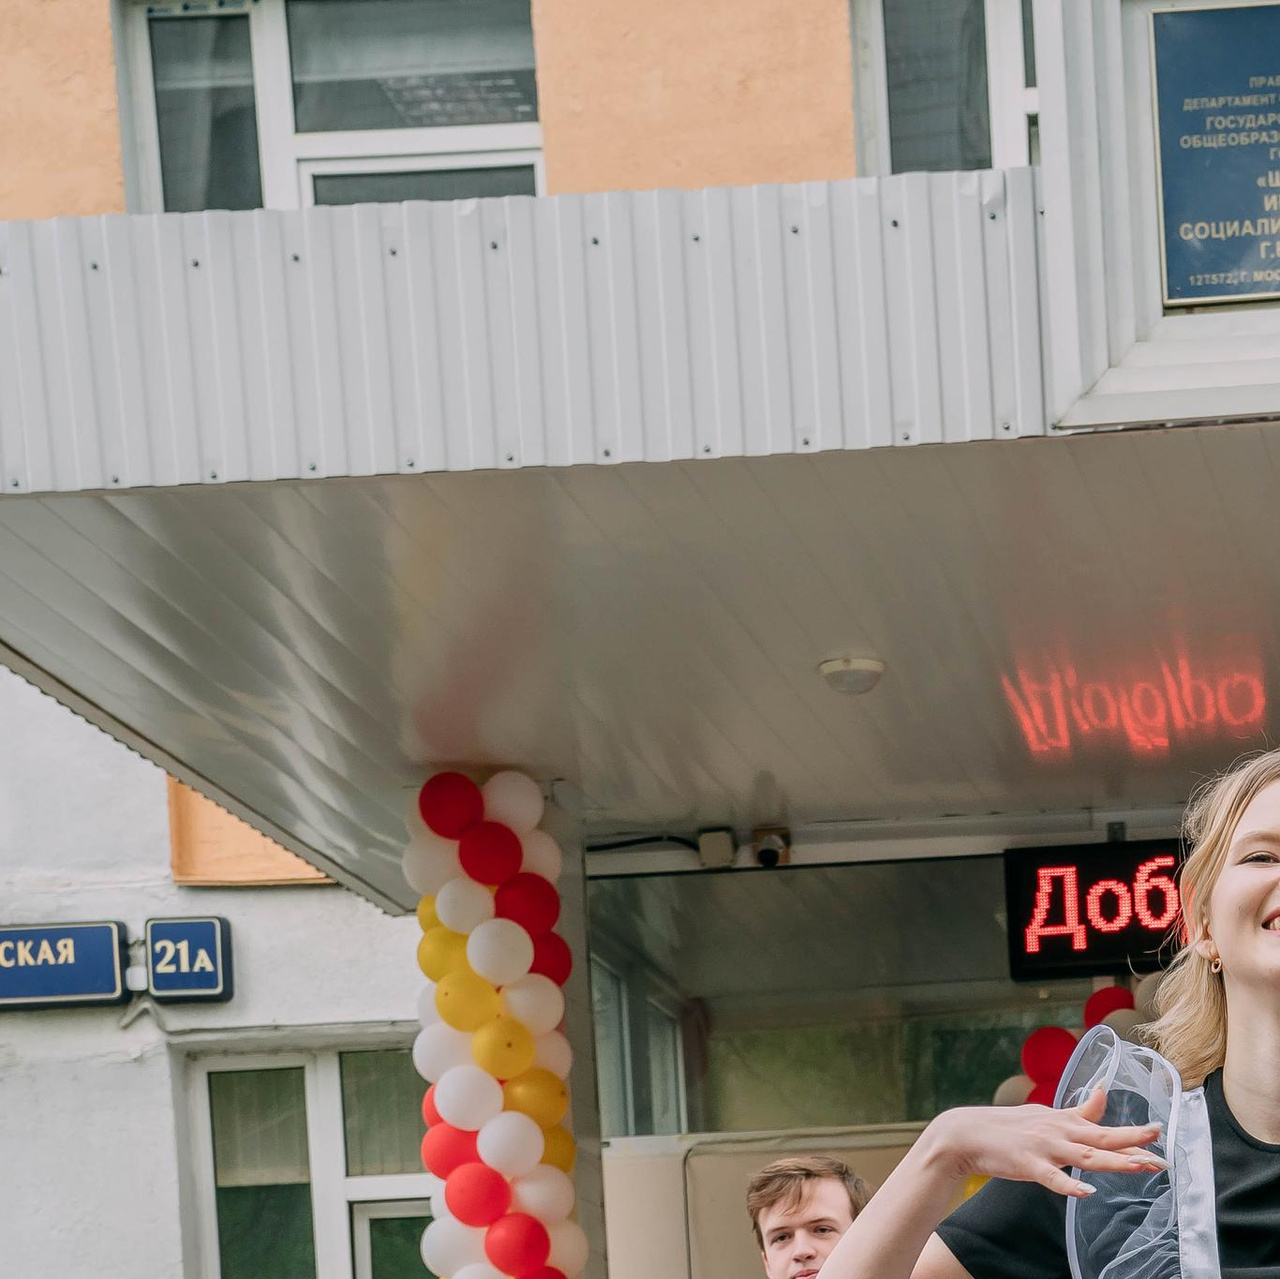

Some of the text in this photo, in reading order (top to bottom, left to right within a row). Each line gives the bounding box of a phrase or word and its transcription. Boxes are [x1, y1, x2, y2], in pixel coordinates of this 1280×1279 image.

[1183, 93, 1276, 111] ДЕПАРТАМЕНТ
[1025, 856, 1188, 954] Доб
[154, 939, 215, 973] 21А
